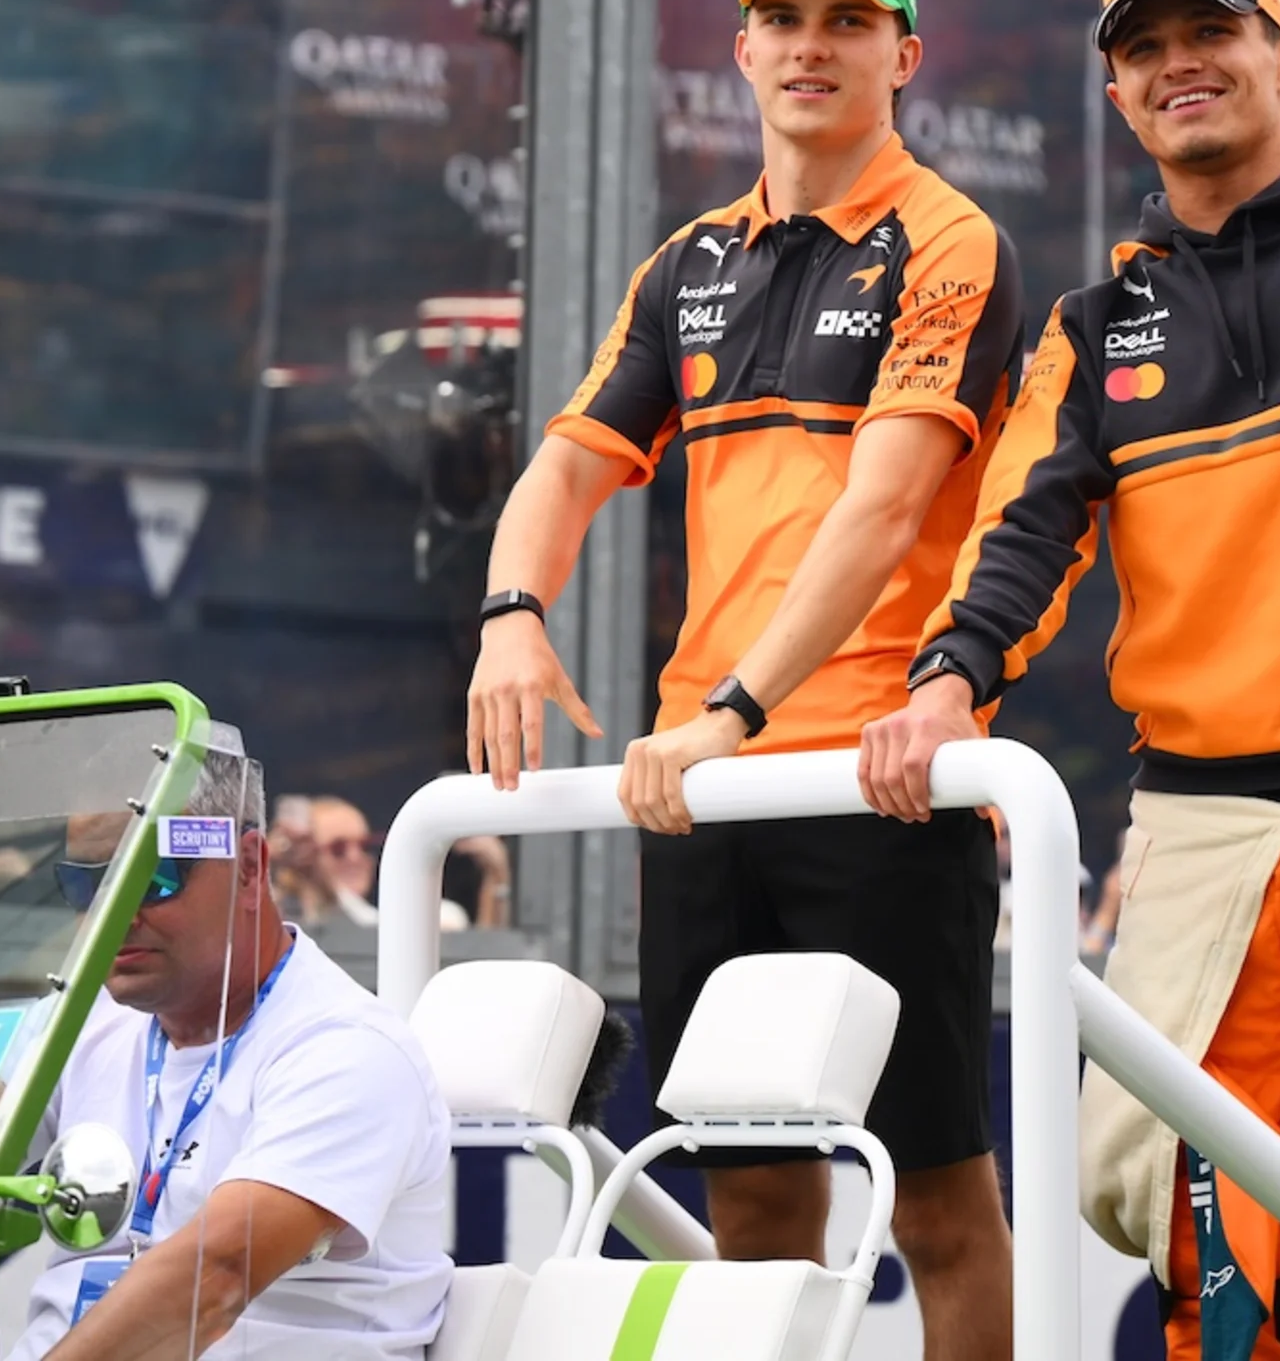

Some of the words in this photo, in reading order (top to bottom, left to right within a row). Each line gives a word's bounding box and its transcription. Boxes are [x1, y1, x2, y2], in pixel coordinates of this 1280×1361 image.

[290, 28, 450, 93] QATAR
[679, 304, 727, 332] DELL
[814, 310, 882, 337] OKX
[1105, 326, 1167, 350] DELL
[891, 354, 949, 373] ECLAB
[172, 830, 227, 847] SCRUTINY
